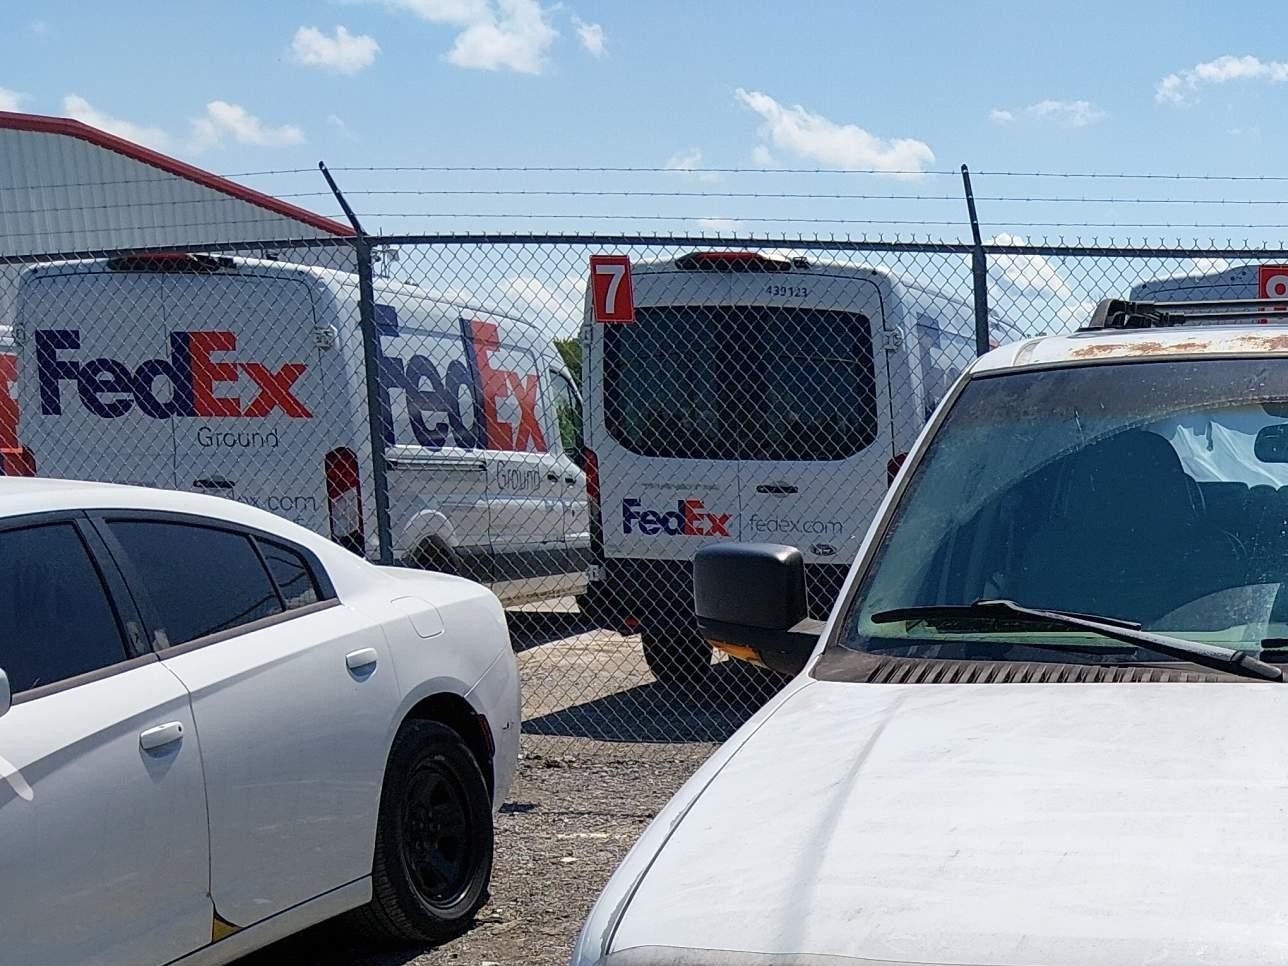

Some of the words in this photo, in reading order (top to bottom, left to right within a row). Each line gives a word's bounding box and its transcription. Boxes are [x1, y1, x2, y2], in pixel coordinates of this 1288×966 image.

[596, 265, 625, 314] 7
[766, 285, 808, 297] 439123
[35, 329, 313, 419] FedEx
[375, 304, 548, 452] FedEx
[197, 426, 279, 448] Ground
[497, 460, 541, 490] Ground
[623, 498, 732, 537] FedEx
[751, 515, 844, 535] fedex.com
